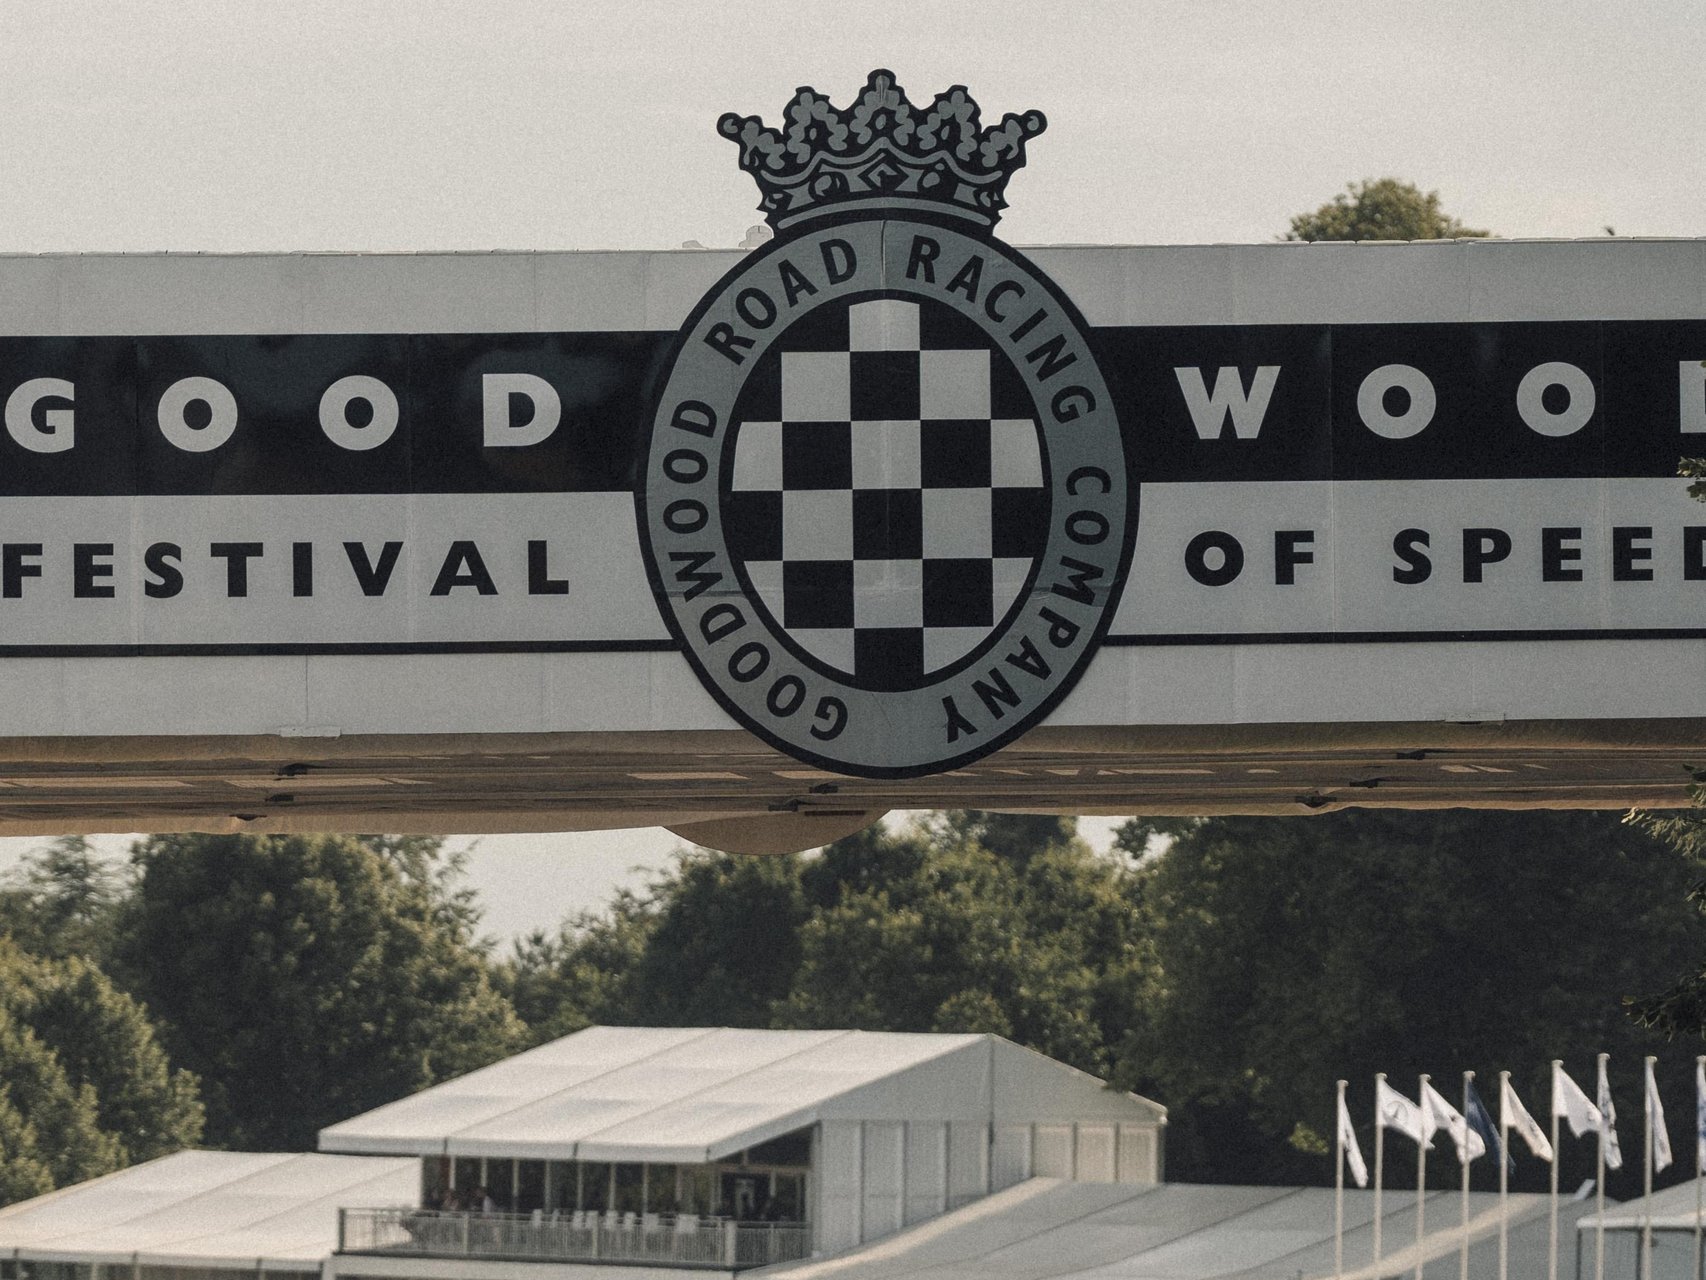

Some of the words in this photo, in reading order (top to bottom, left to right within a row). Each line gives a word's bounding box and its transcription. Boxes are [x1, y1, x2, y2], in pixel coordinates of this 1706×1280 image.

[703, 237, 857, 366] ROAD
[906, 234, 1097, 425] RACING
[4, 372, 562, 453] GOOD
[2, 540, 570, 599] FESTIVAL
[1185, 530, 1315, 587] OF
[662, 398, 849, 742] GOODWOOD
[940, 465, 1112, 744] COMPANY
